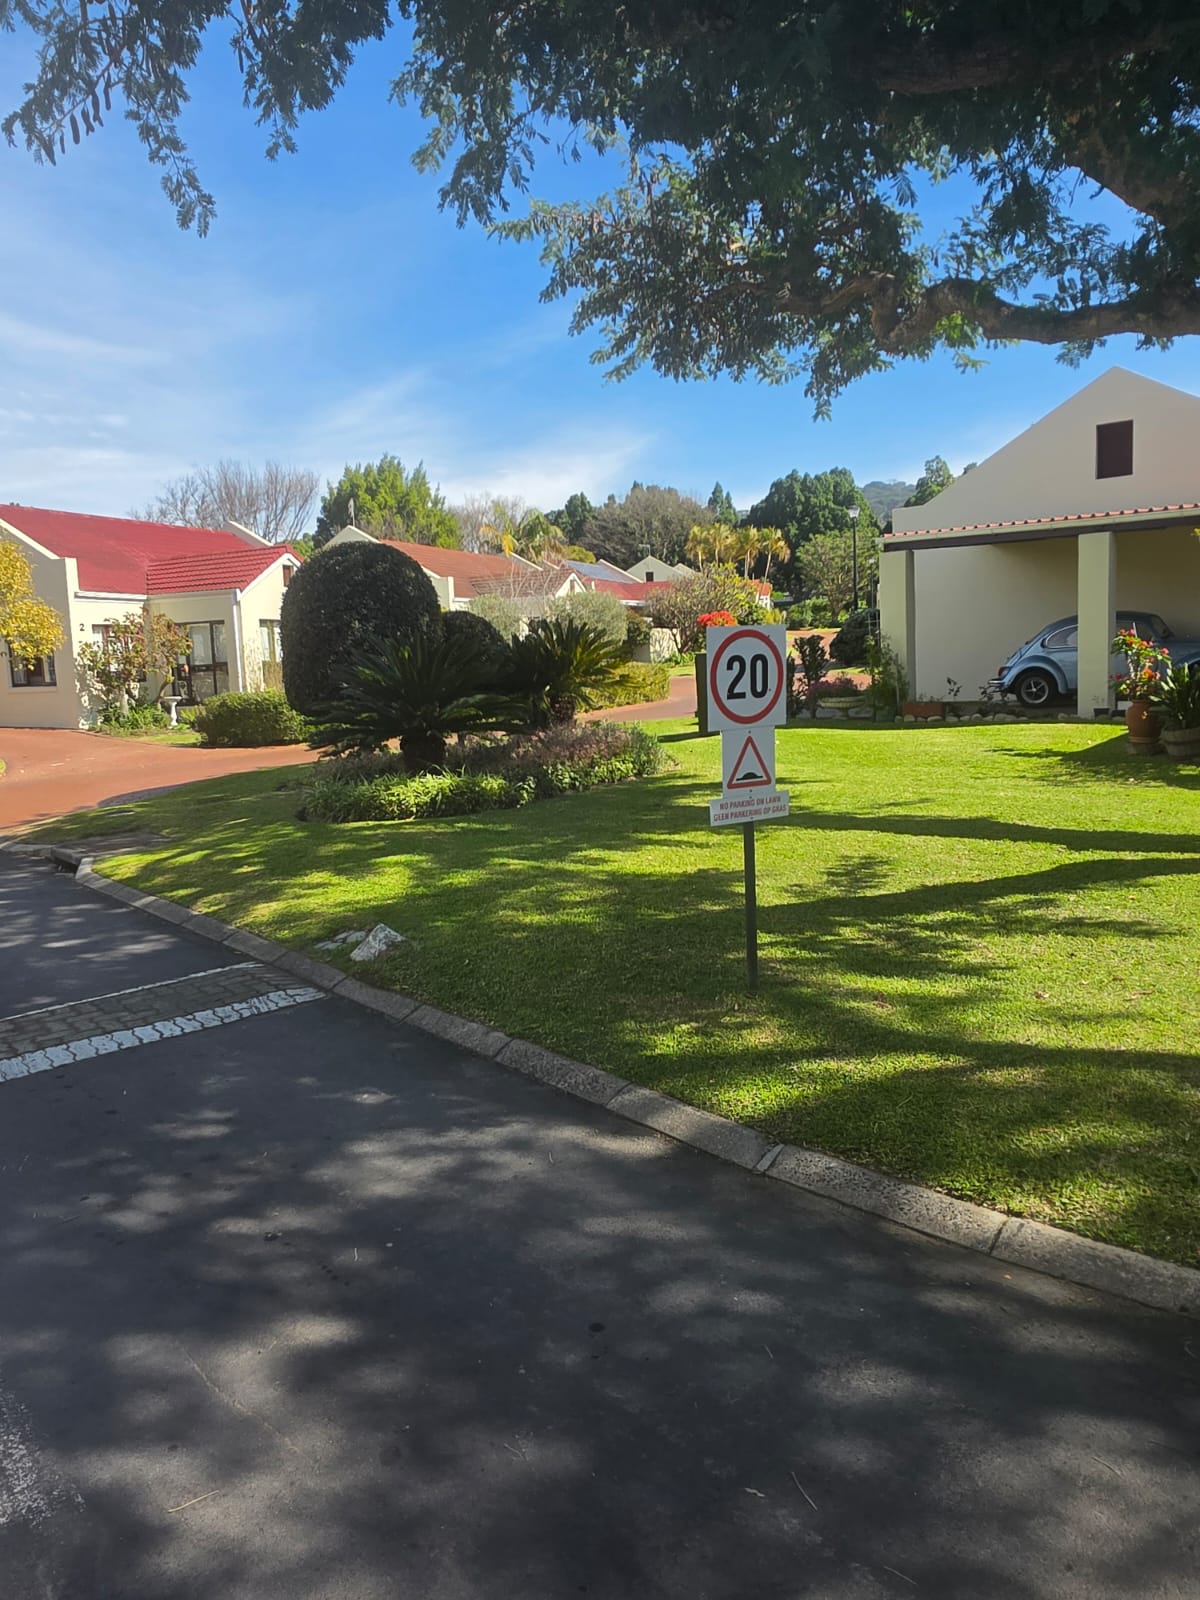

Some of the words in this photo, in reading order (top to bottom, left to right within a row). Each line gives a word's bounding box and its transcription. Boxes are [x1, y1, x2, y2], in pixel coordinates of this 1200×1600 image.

[79, 623, 85, 631] 2
[726, 653, 769, 700] 20
[719, 802, 729, 810] NO
[729, 799, 755, 809] PARKING
[756, 798, 765, 806] ON
[765, 796, 781, 805] LAWN
[713, 813, 729, 822] GEEN
[730, 808, 762, 820] PARKERING
[763, 806, 771, 814] OP
[772, 804, 787, 813] GRAS
